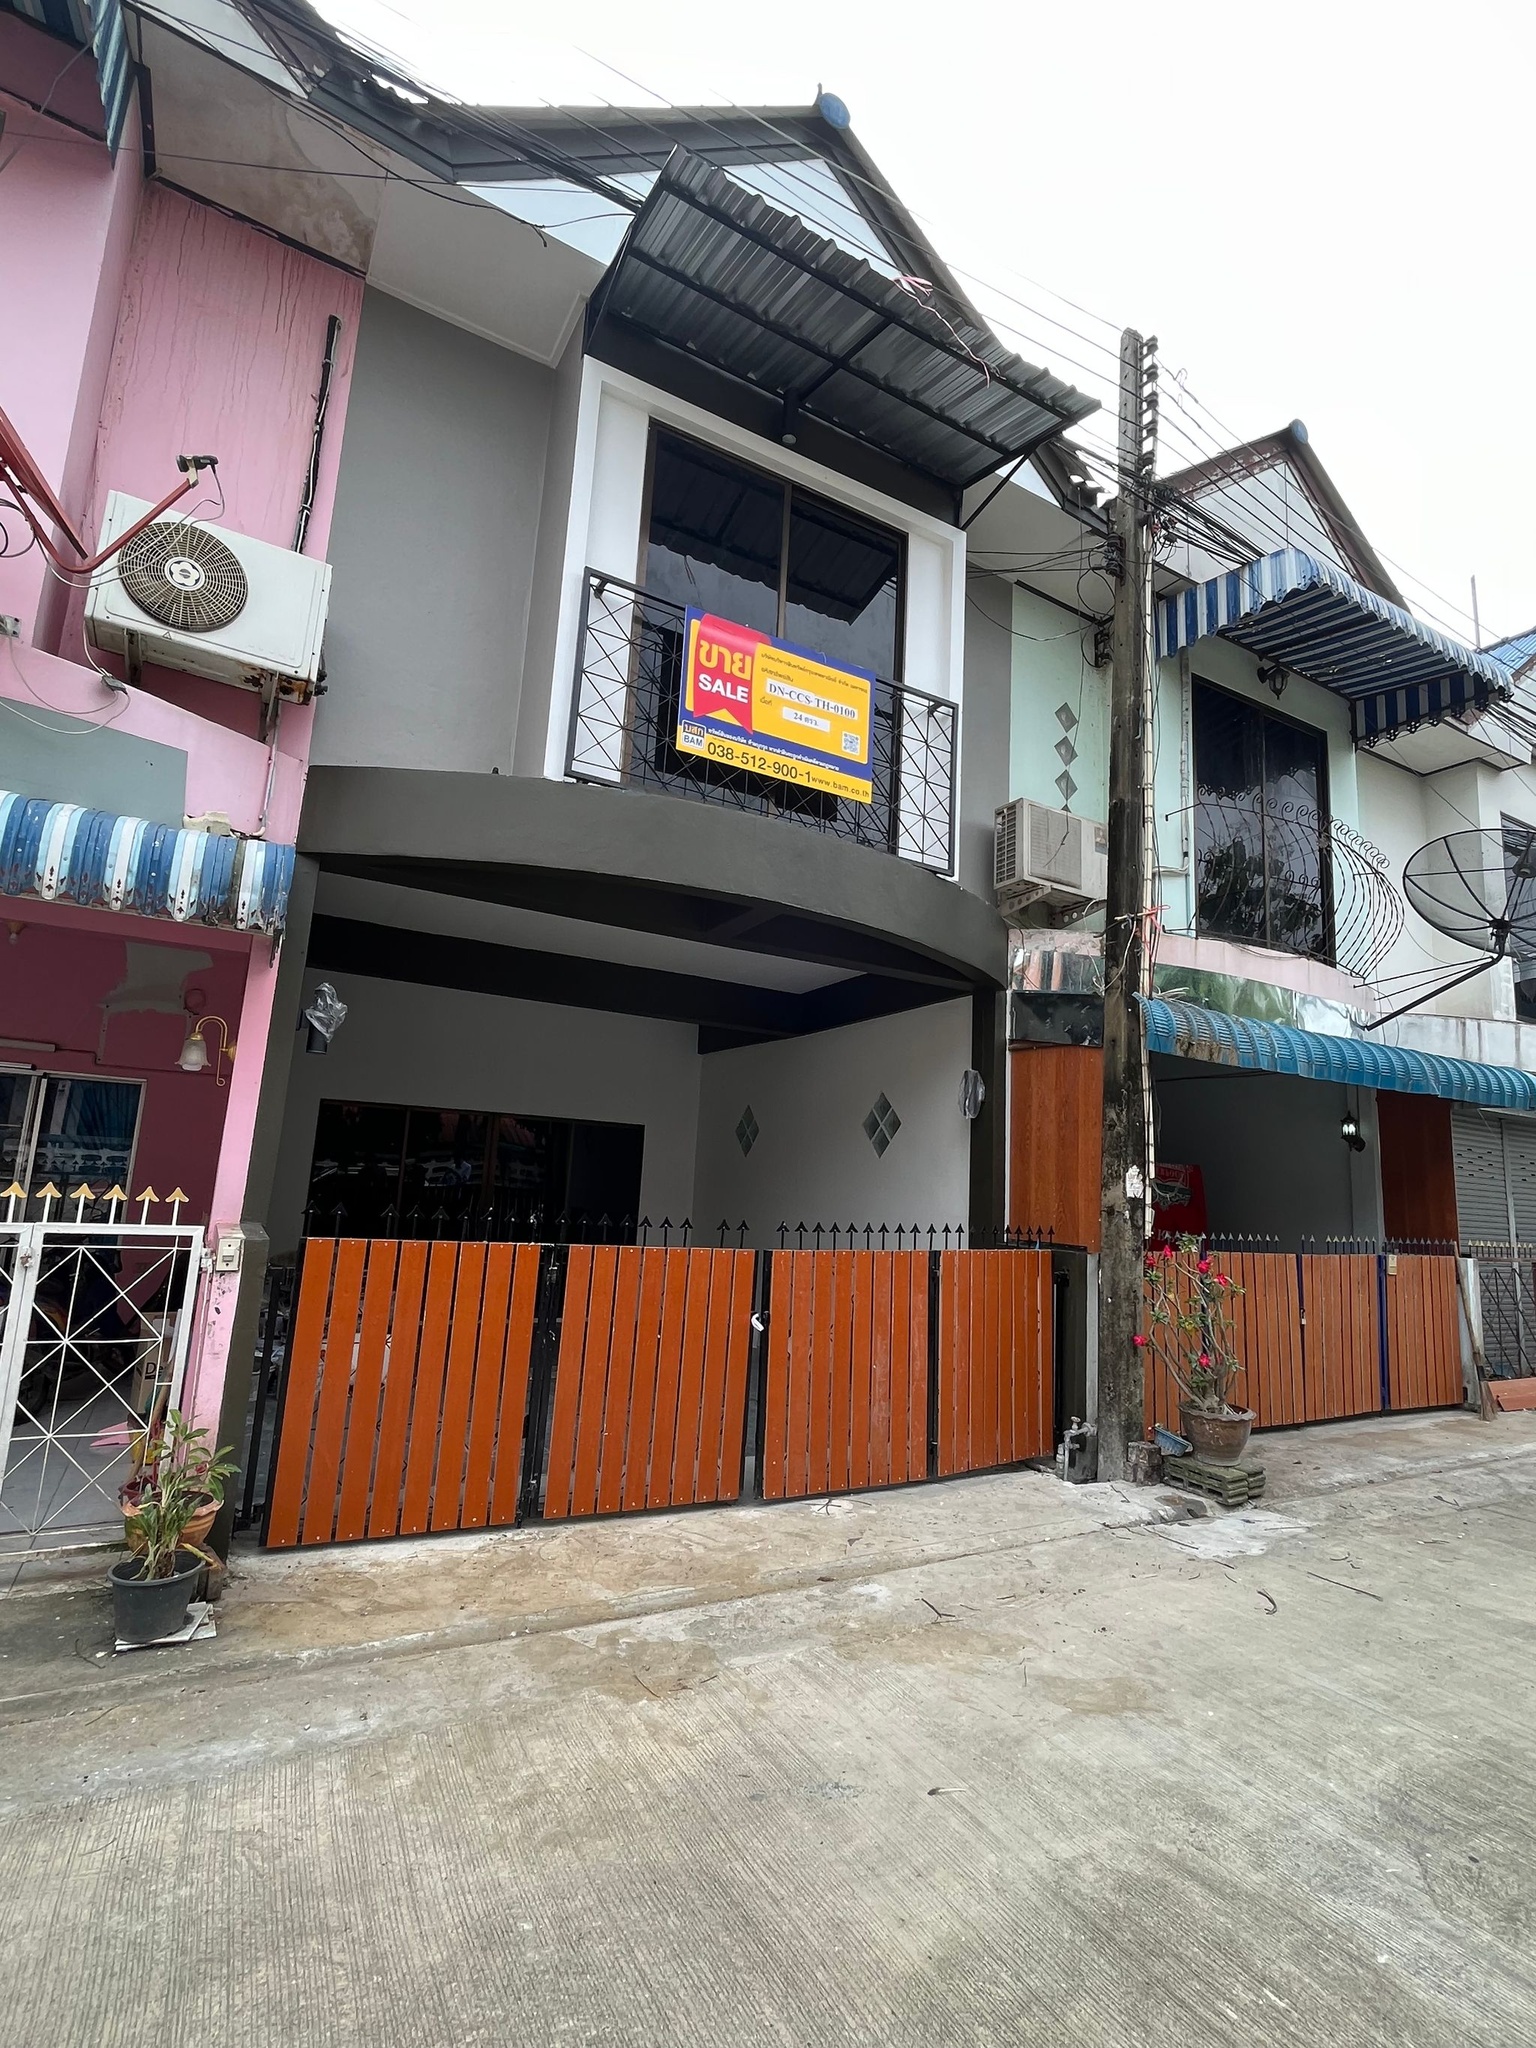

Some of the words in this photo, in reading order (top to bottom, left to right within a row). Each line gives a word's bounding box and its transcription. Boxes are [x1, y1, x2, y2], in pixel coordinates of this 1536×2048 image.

[699, 640, 752, 681] ขาย
[698, 673, 749, 704] SALE
[793, 711, 803, 722] 24
[683, 734, 703, 747] BAM
[707, 741, 811, 783] 038-512-900-1
[811, 776, 869, 798] www.bam.co.th
